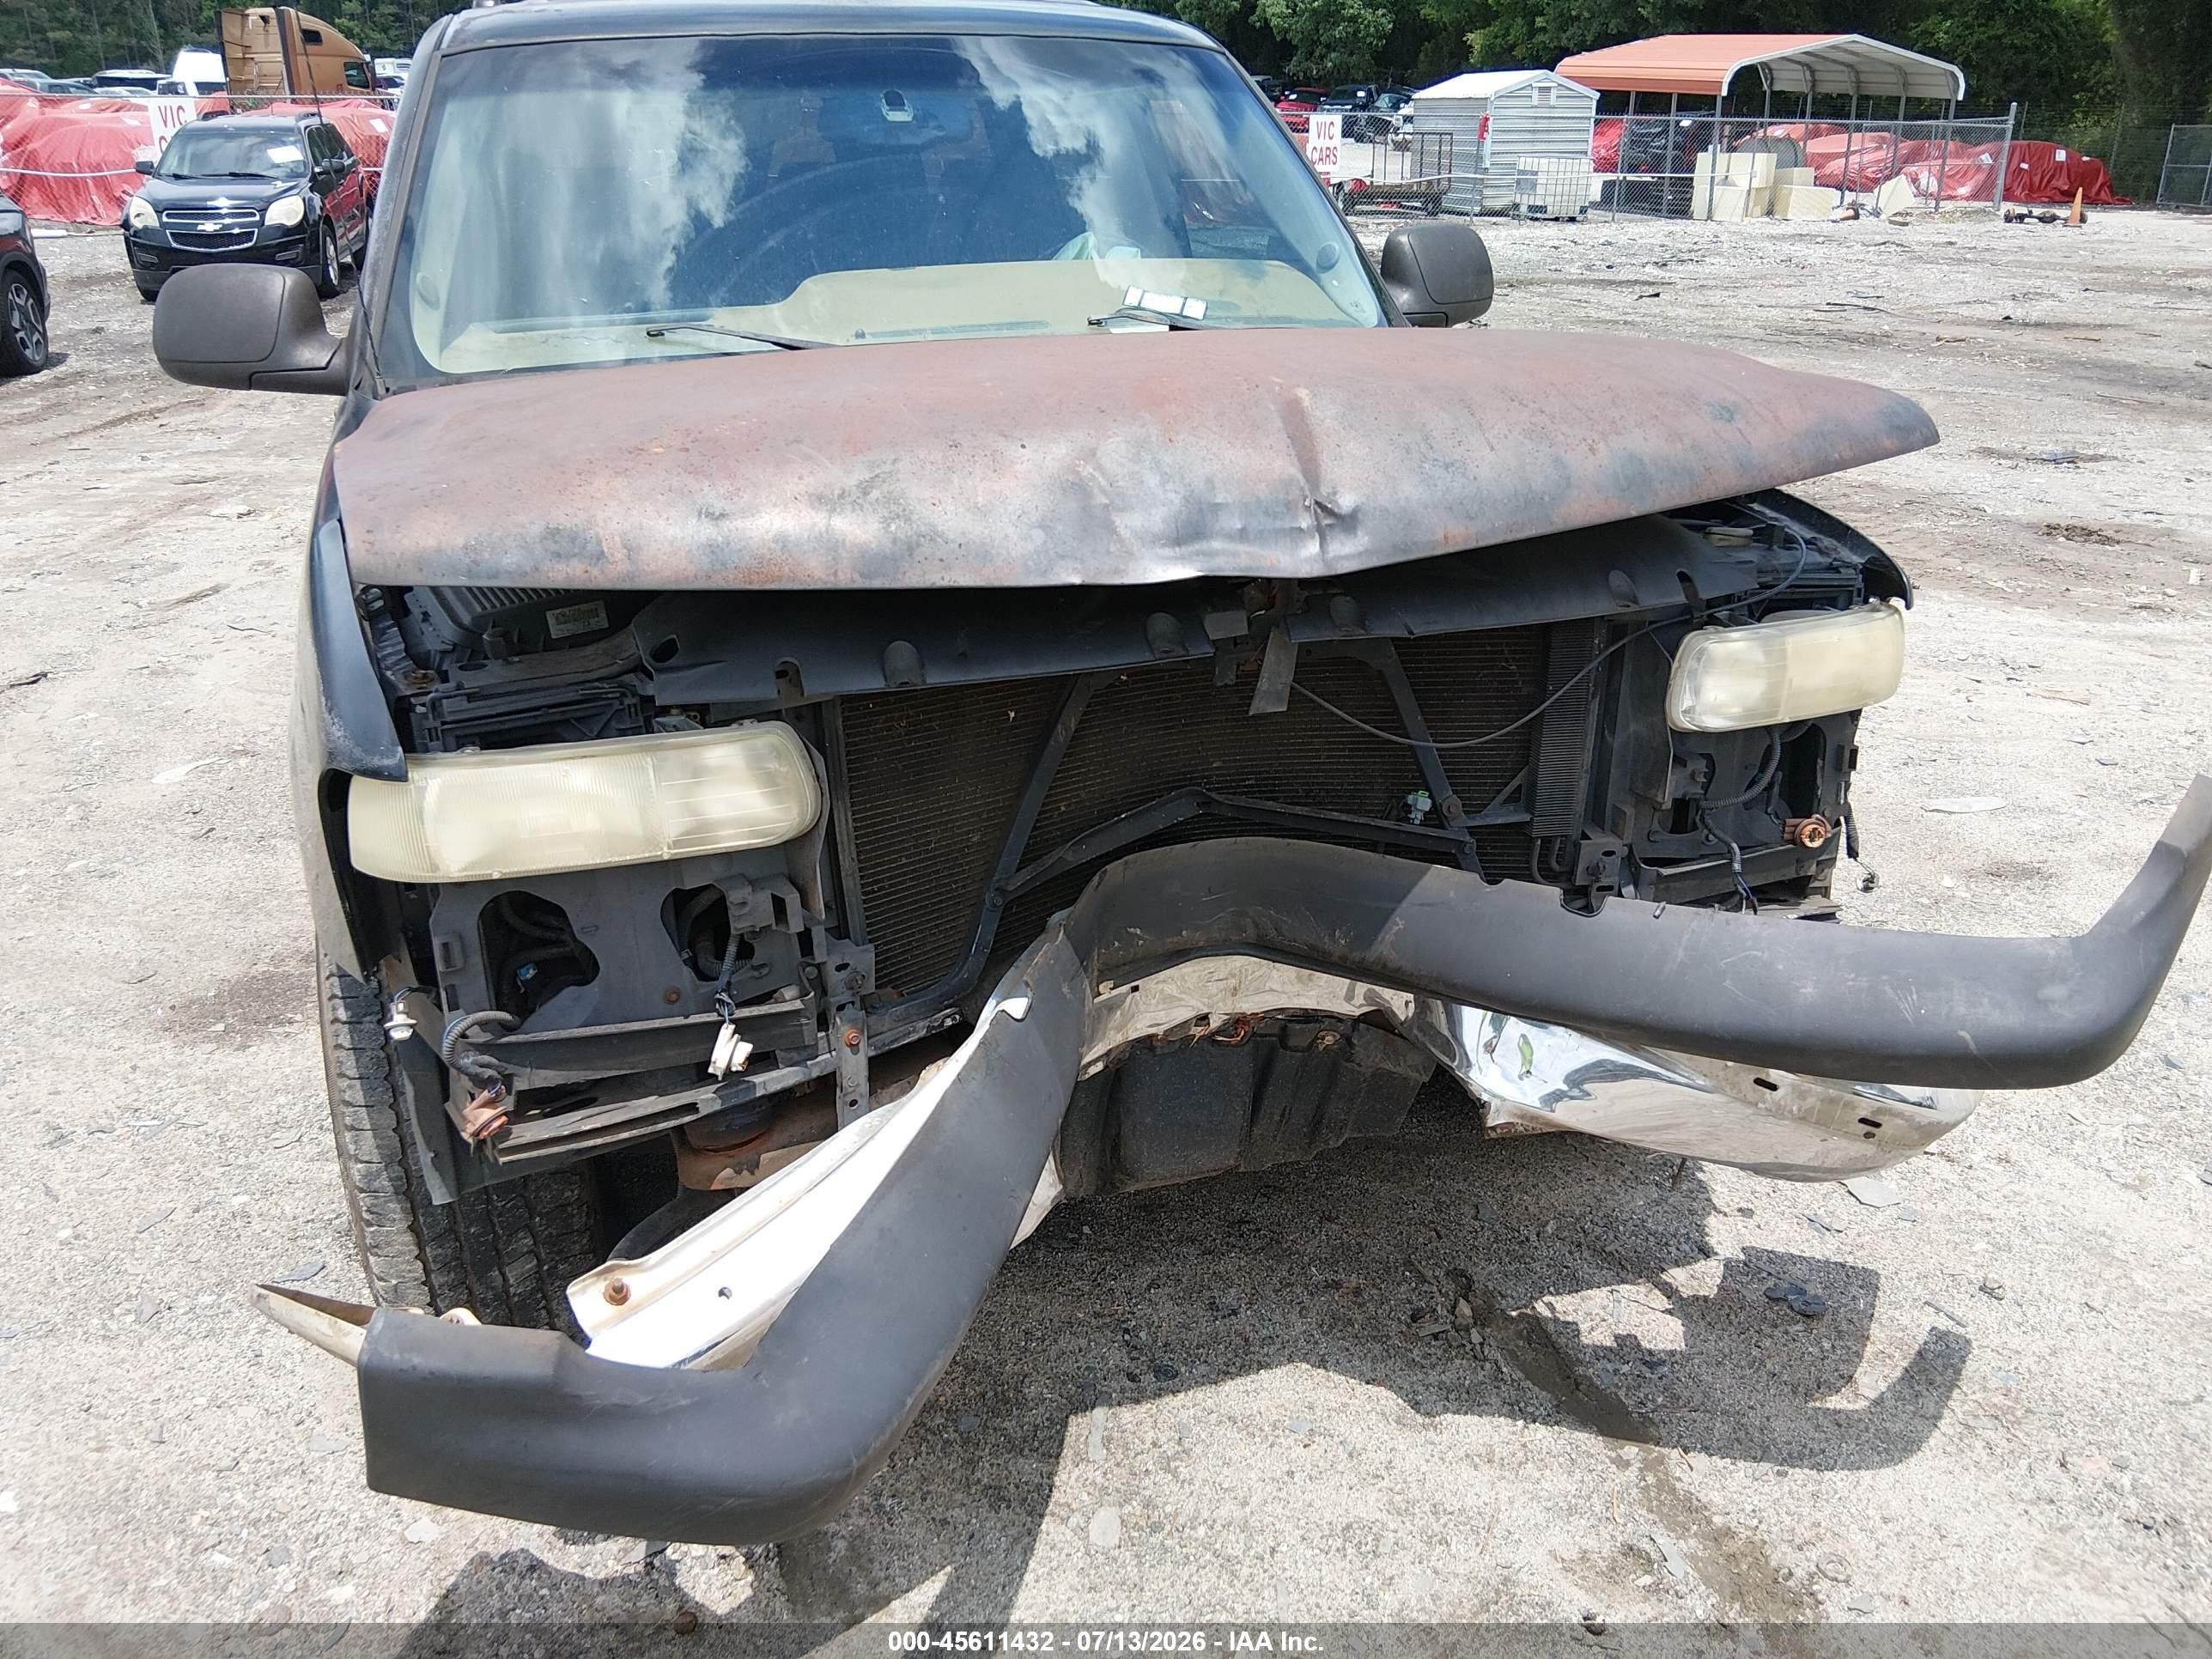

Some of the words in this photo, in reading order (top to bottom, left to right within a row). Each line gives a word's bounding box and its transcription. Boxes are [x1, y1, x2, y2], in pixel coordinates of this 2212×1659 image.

[157, 105, 186, 128] VIC
[1316, 120, 1334, 141] VIC
[1310, 146, 1338, 166] CARS
